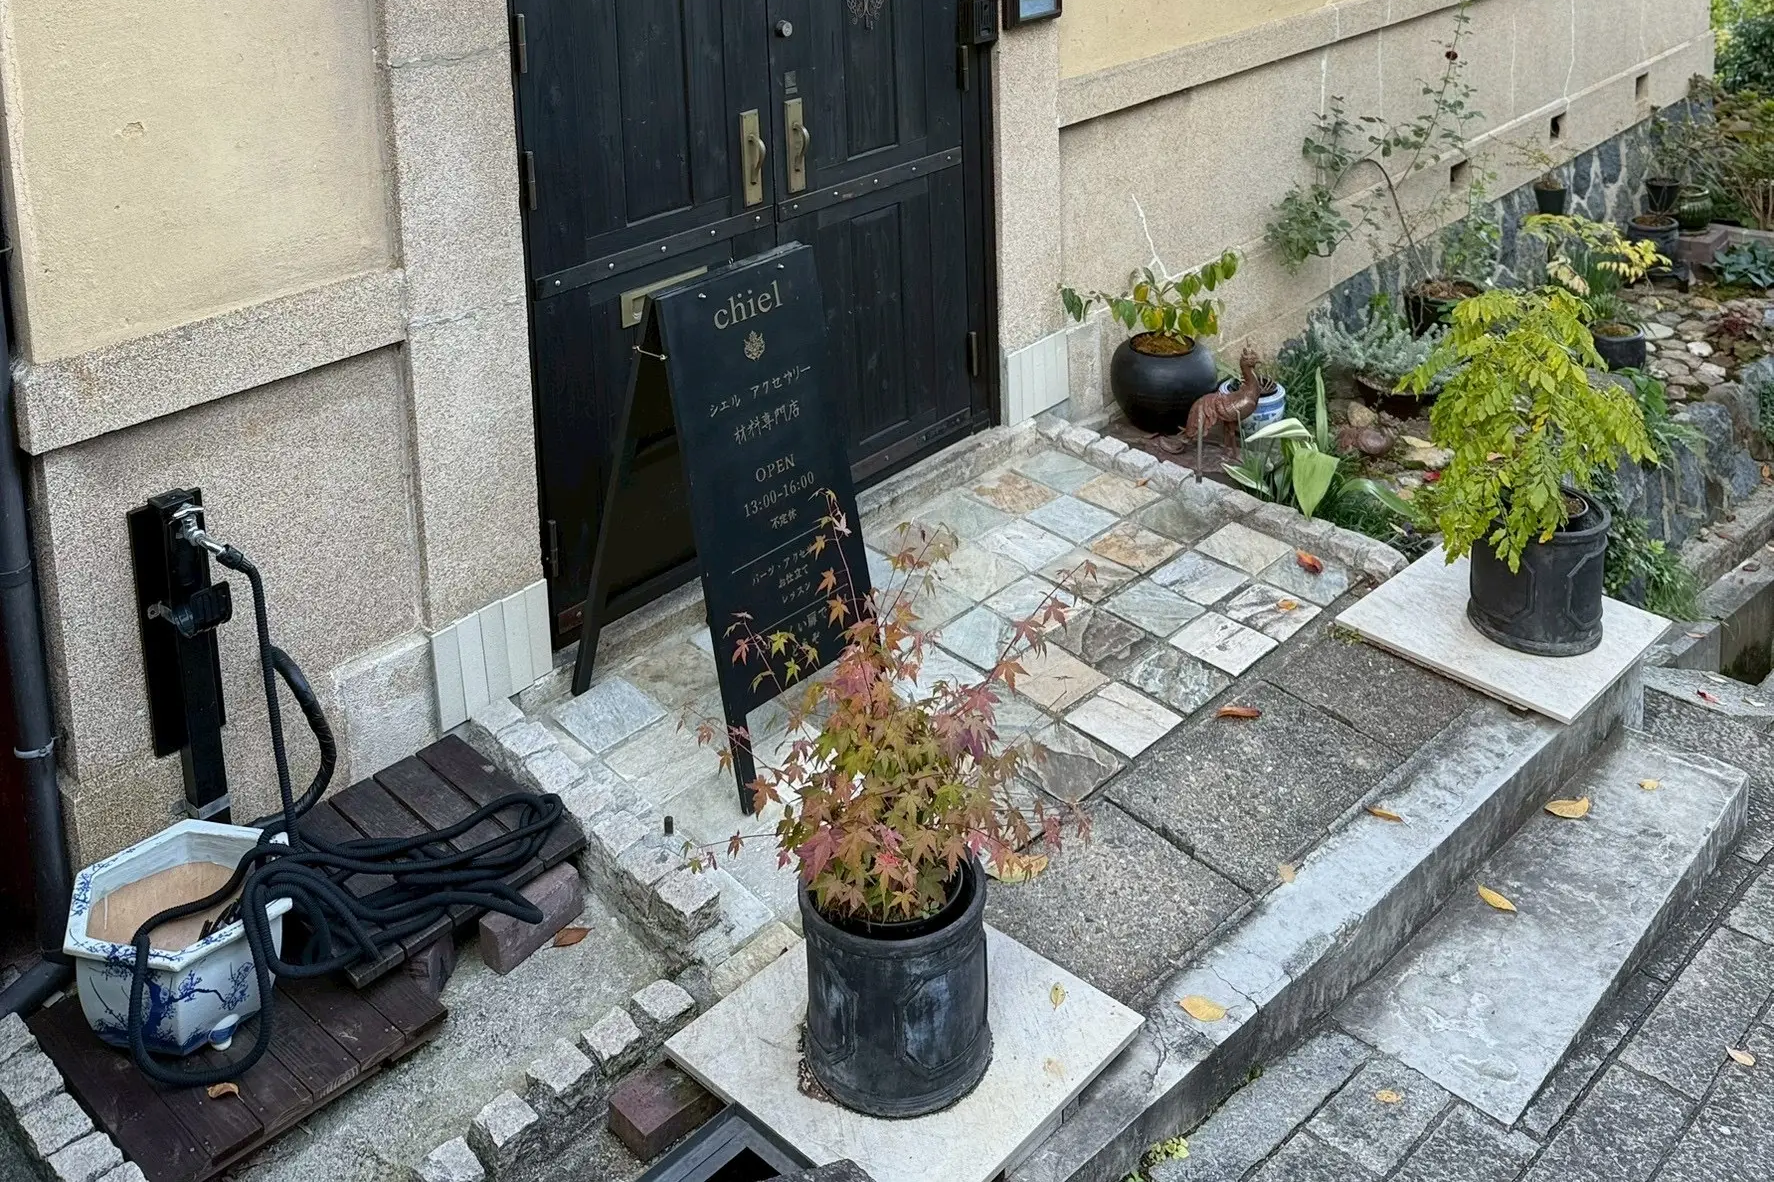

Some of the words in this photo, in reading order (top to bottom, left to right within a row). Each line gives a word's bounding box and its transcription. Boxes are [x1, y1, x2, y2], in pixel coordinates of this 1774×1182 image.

[751, 365, 811, 399] アクセサリー
[734, 399, 800, 445] 材料専門店
[755, 454, 796, 483] OPEN
[744, 471, 815, 518] 13:00-16:00
[769, 508, 798, 530] 不定休
